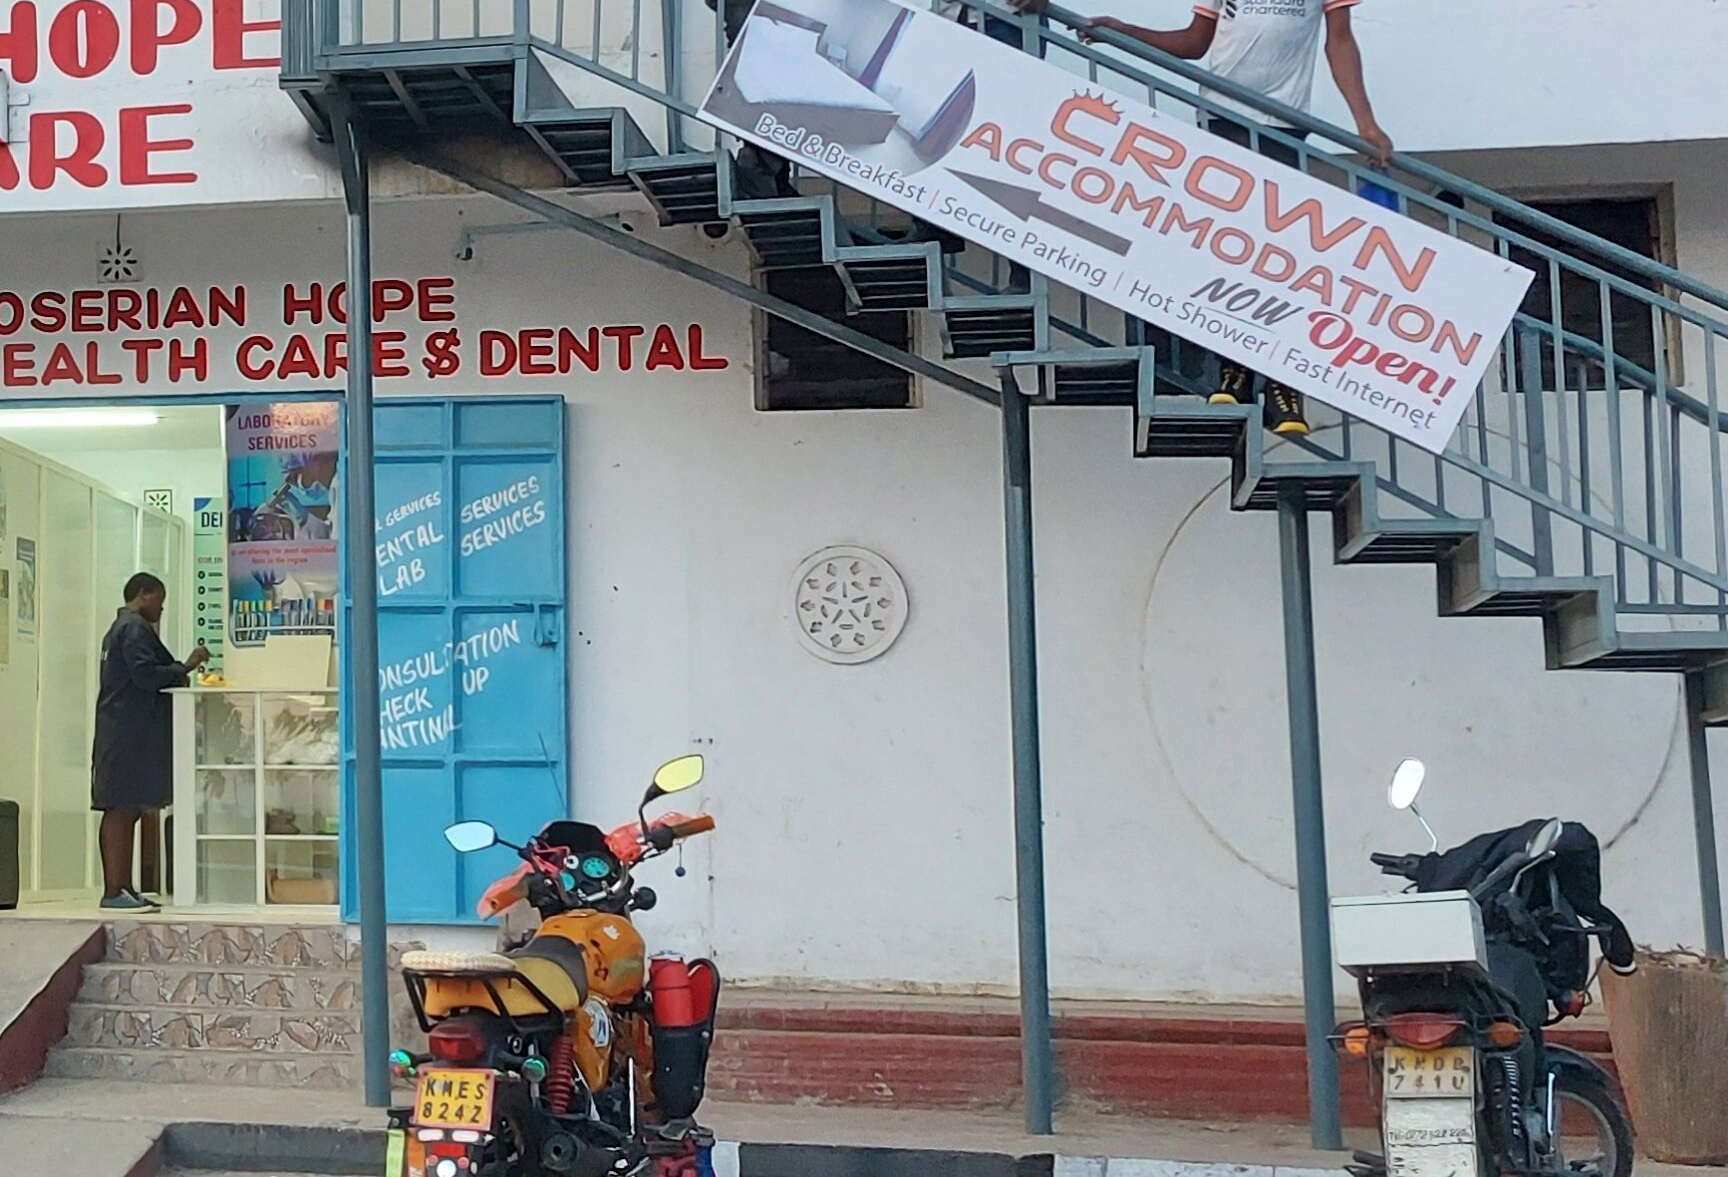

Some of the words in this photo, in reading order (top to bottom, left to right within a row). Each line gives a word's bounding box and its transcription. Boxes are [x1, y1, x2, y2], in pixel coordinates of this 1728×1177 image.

[1243, 5, 1306, 17] chartered
[1050, 90, 1437, 293] CROWN
[755, 112, 800, 149] Bed
[801, 134, 824, 159] &
[825, 143, 928, 204] Breakfast
[940, 196, 1017, 244] Secure
[1020, 231, 1108, 287] Parking
[1128, 279, 1175, 314] Hot
[1176, 301, 1270, 354] Shower
[1282, 347, 1330, 385] Fast
[1335, 373, 1441, 430] Internet
[960, 122, 1483, 366] ACCOMMODATION
[283, 276, 456, 326] HOPE
[236, 331, 411, 381] CARE
[479, 324, 729, 377] DENTAL
[1189, 276, 1305, 327] NOW
[1308, 310, 1457, 407] Open!
[248, 434, 317, 451] SERVICES
[201, 512, 223, 527] DE
[375, 522, 444, 567] ENTAL
[460, 475, 540, 523] SERVICES
[386, 490, 442, 527] SERVICES
[379, 558, 426, 596] LAB
[460, 501, 546, 557] SERVICES
[379, 620, 521, 693] ONSULTATION
[380, 687, 433, 725] HECK
[462, 666, 489, 696] UP
[422, 1101, 483, 1123] 824Z
